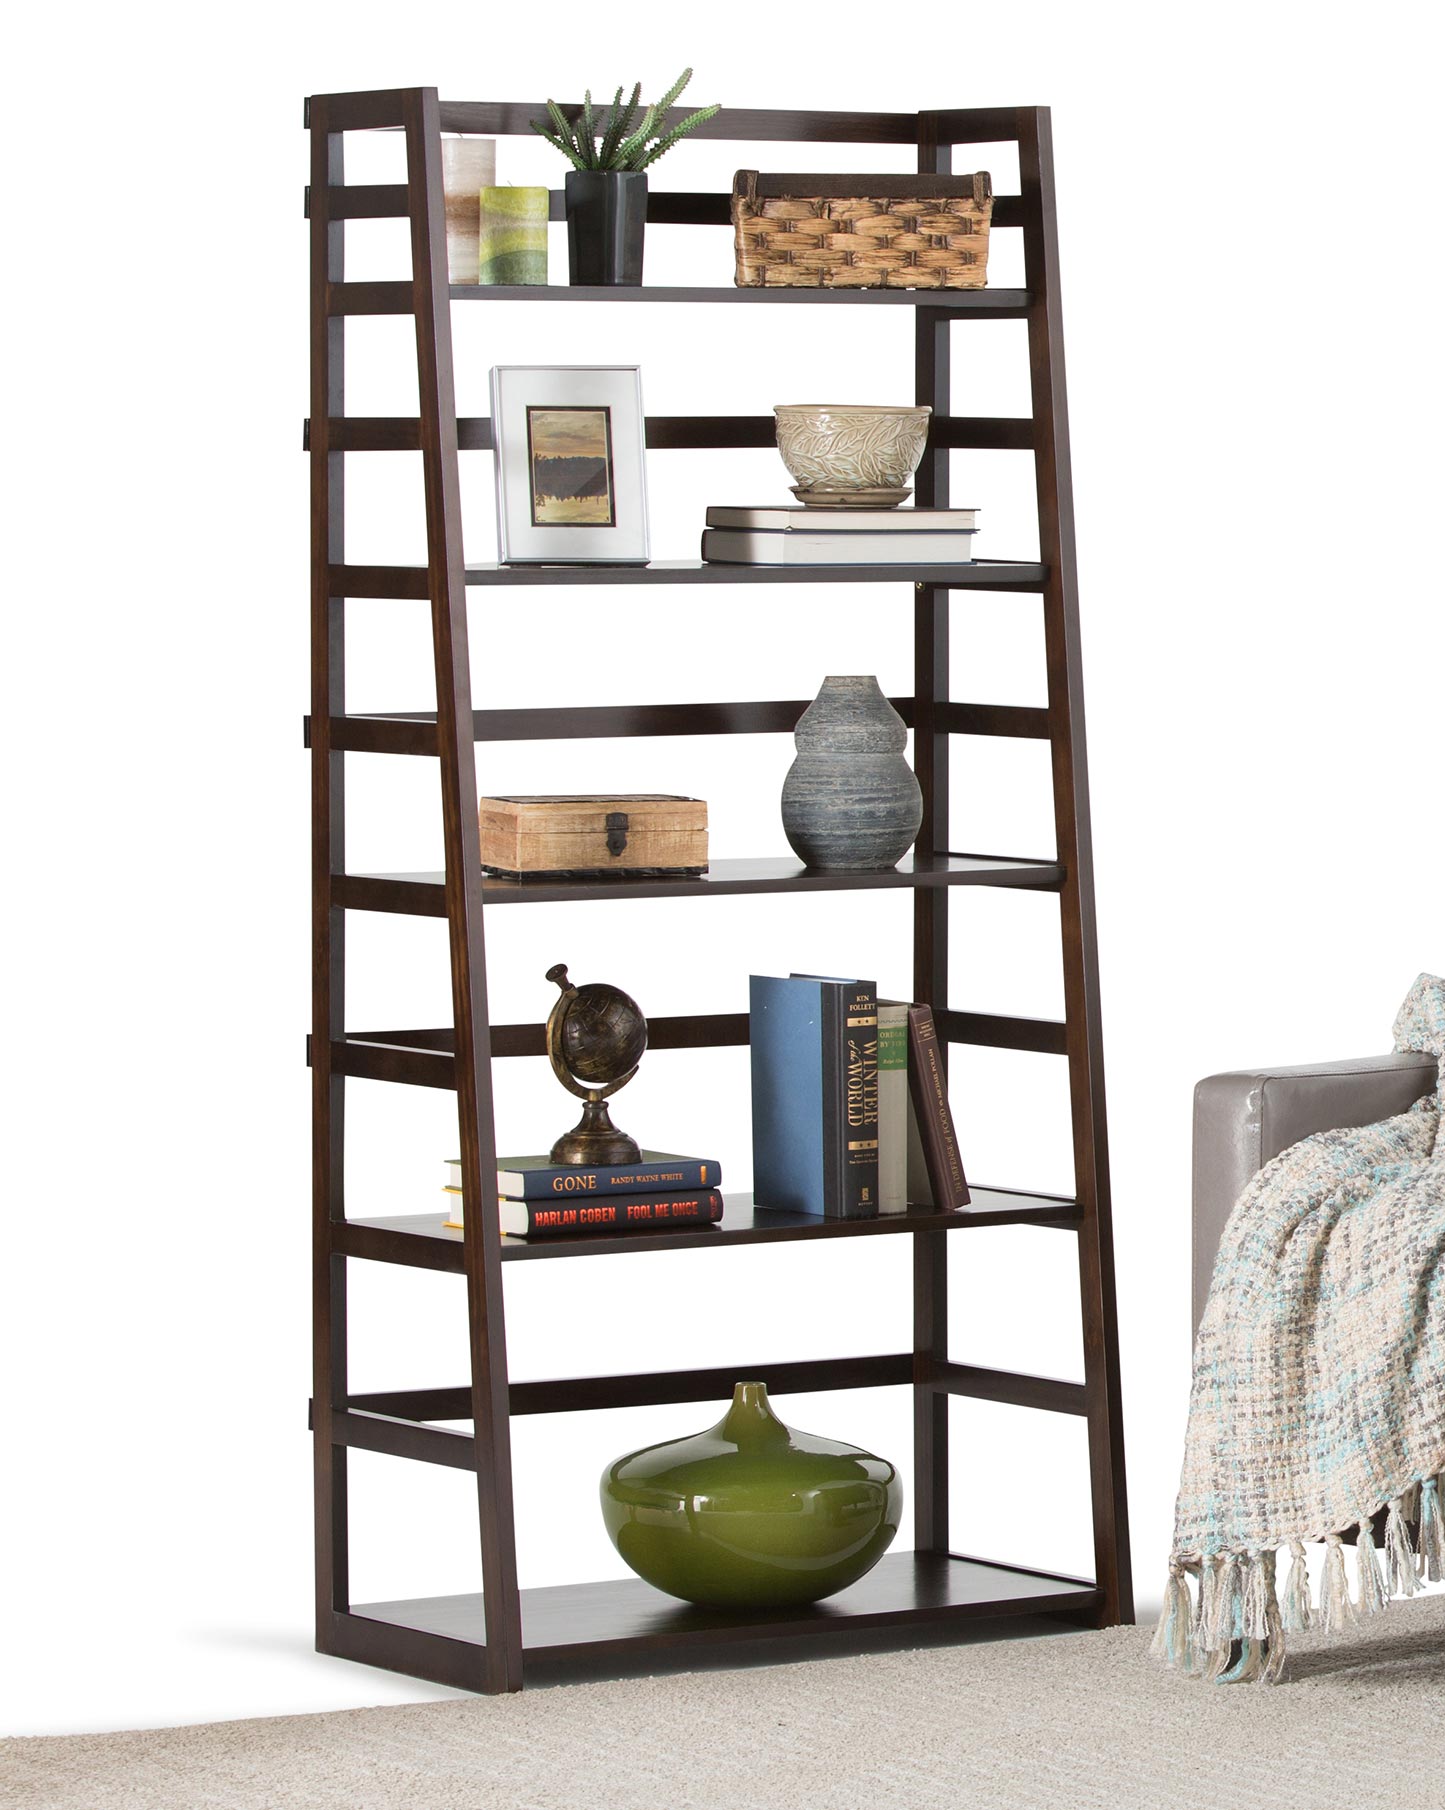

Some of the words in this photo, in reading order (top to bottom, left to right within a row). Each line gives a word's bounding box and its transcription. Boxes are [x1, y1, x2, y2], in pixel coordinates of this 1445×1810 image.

[849, 1003, 876, 1011] FOLLETT
[847, 1040, 861, 1054] of
[928, 1048, 936, 1072] POLLAN
[847, 1061, 863, 1127] WORLD
[863, 1040, 878, 1126] WINTER
[933, 1072, 942, 1099] MICHAEL
[940, 1108, 950, 1134] FOOD
[947, 1144, 960, 1182] DEFENSE
[552, 1175, 597, 1192] GONE
[611, 1176, 635, 1185] RANDY
[636, 1174, 660, 1184] WAYNE
[660, 1172, 684, 1182] WHITE
[535, 1210, 578, 1228] HARLAN
[579, 1206, 617, 1224] COBEN
[627, 1205, 654, 1219] FOOL
[655, 1203, 670, 1218] ME
[672, 1200, 699, 1217] ONCE
